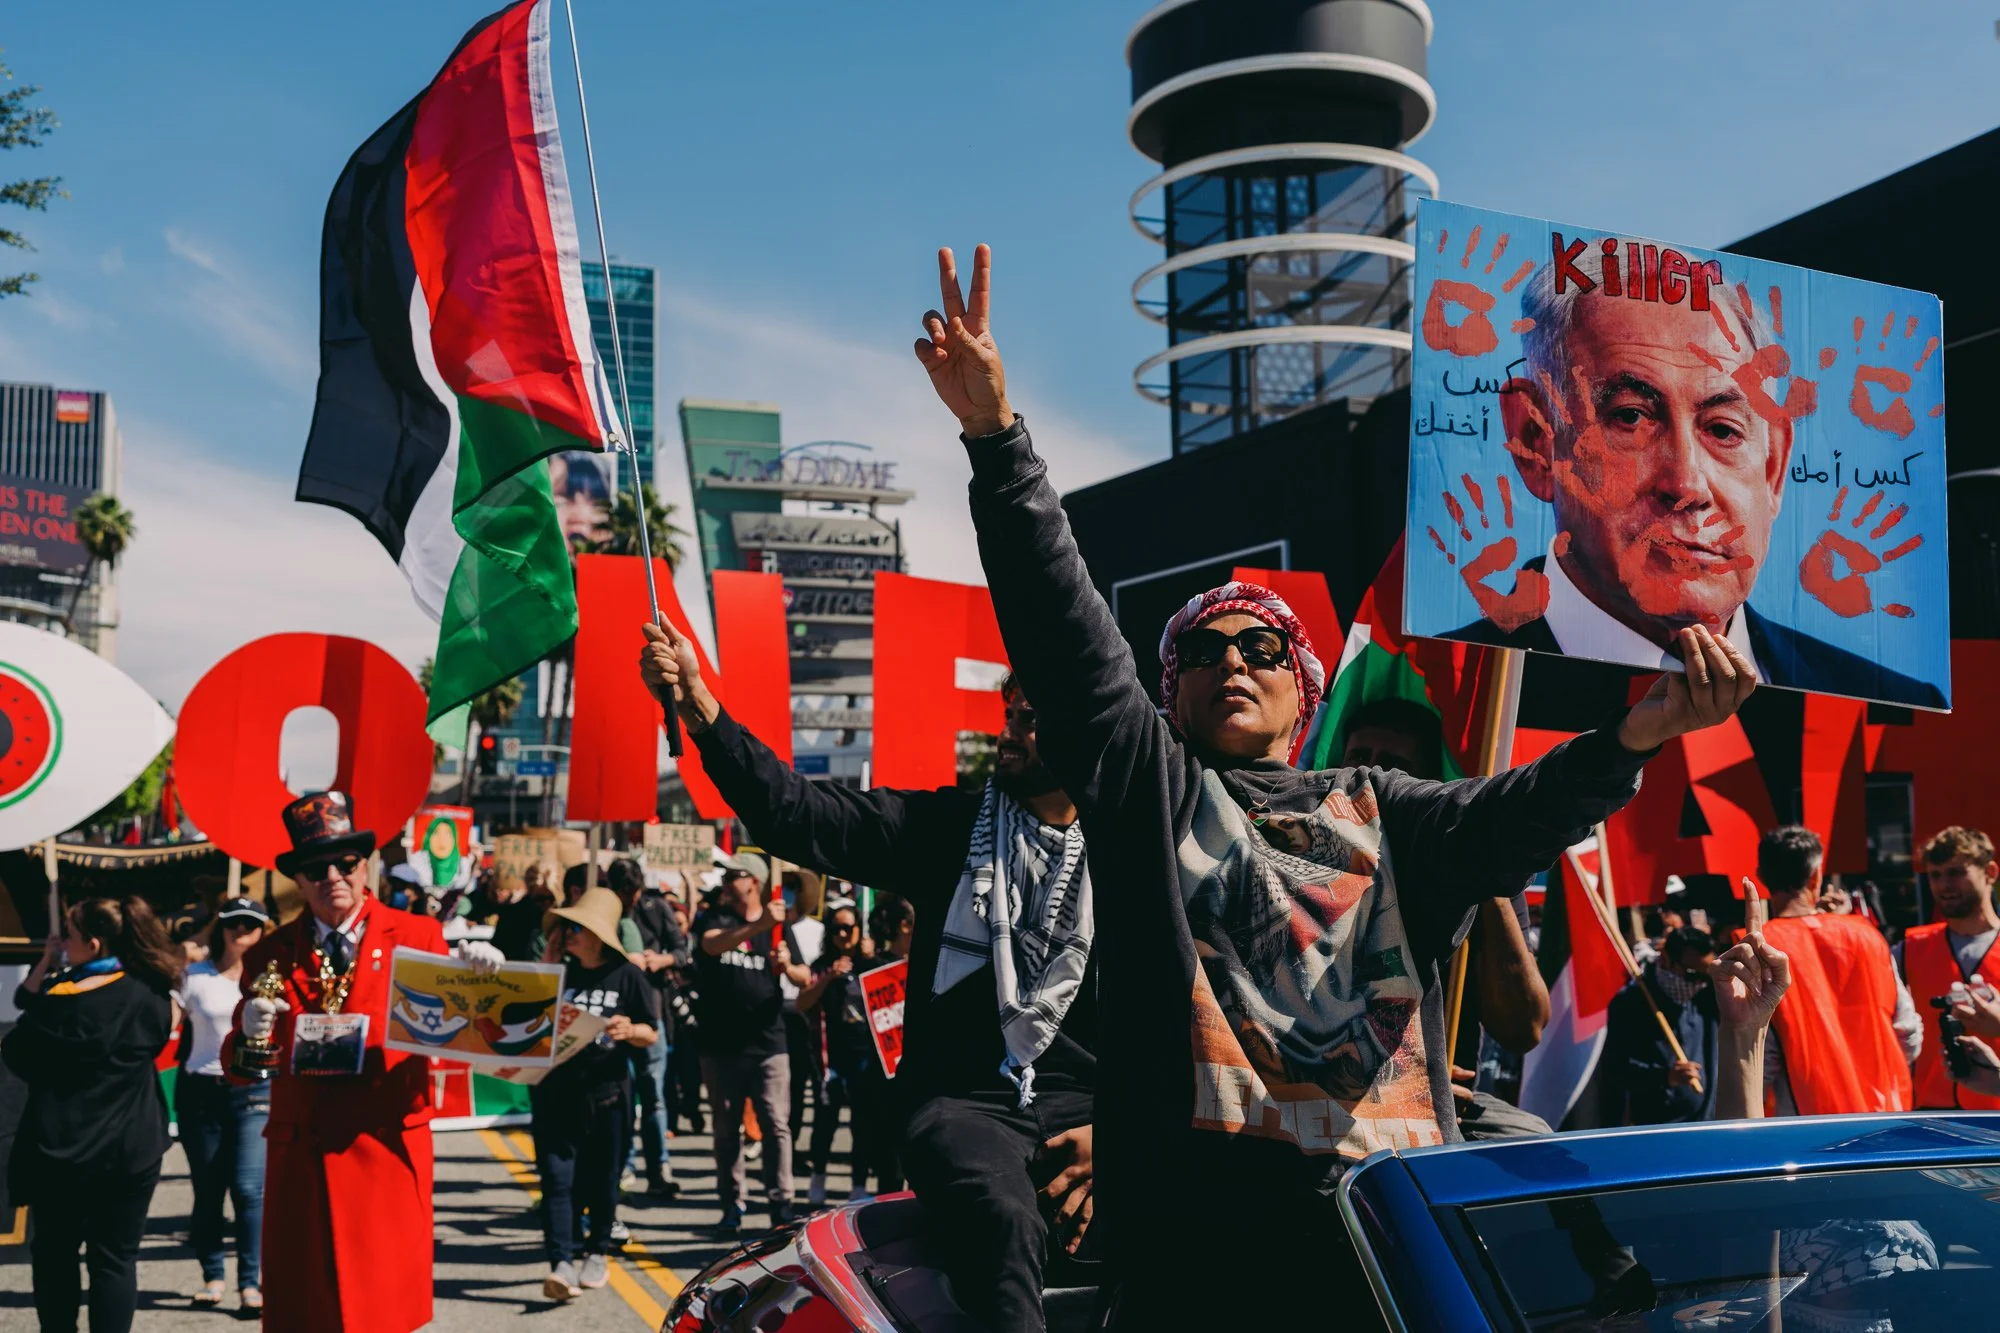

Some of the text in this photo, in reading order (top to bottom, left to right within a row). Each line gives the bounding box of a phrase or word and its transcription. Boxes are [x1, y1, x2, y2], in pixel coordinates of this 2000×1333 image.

[1551, 231, 1724, 312] Killer
[25, 489, 68, 517] THE
[0, 510, 31, 537] EN
[499, 838, 545, 857] FREE
[660, 826, 700, 844] FREE
[867, 982, 897, 1011] STOP
